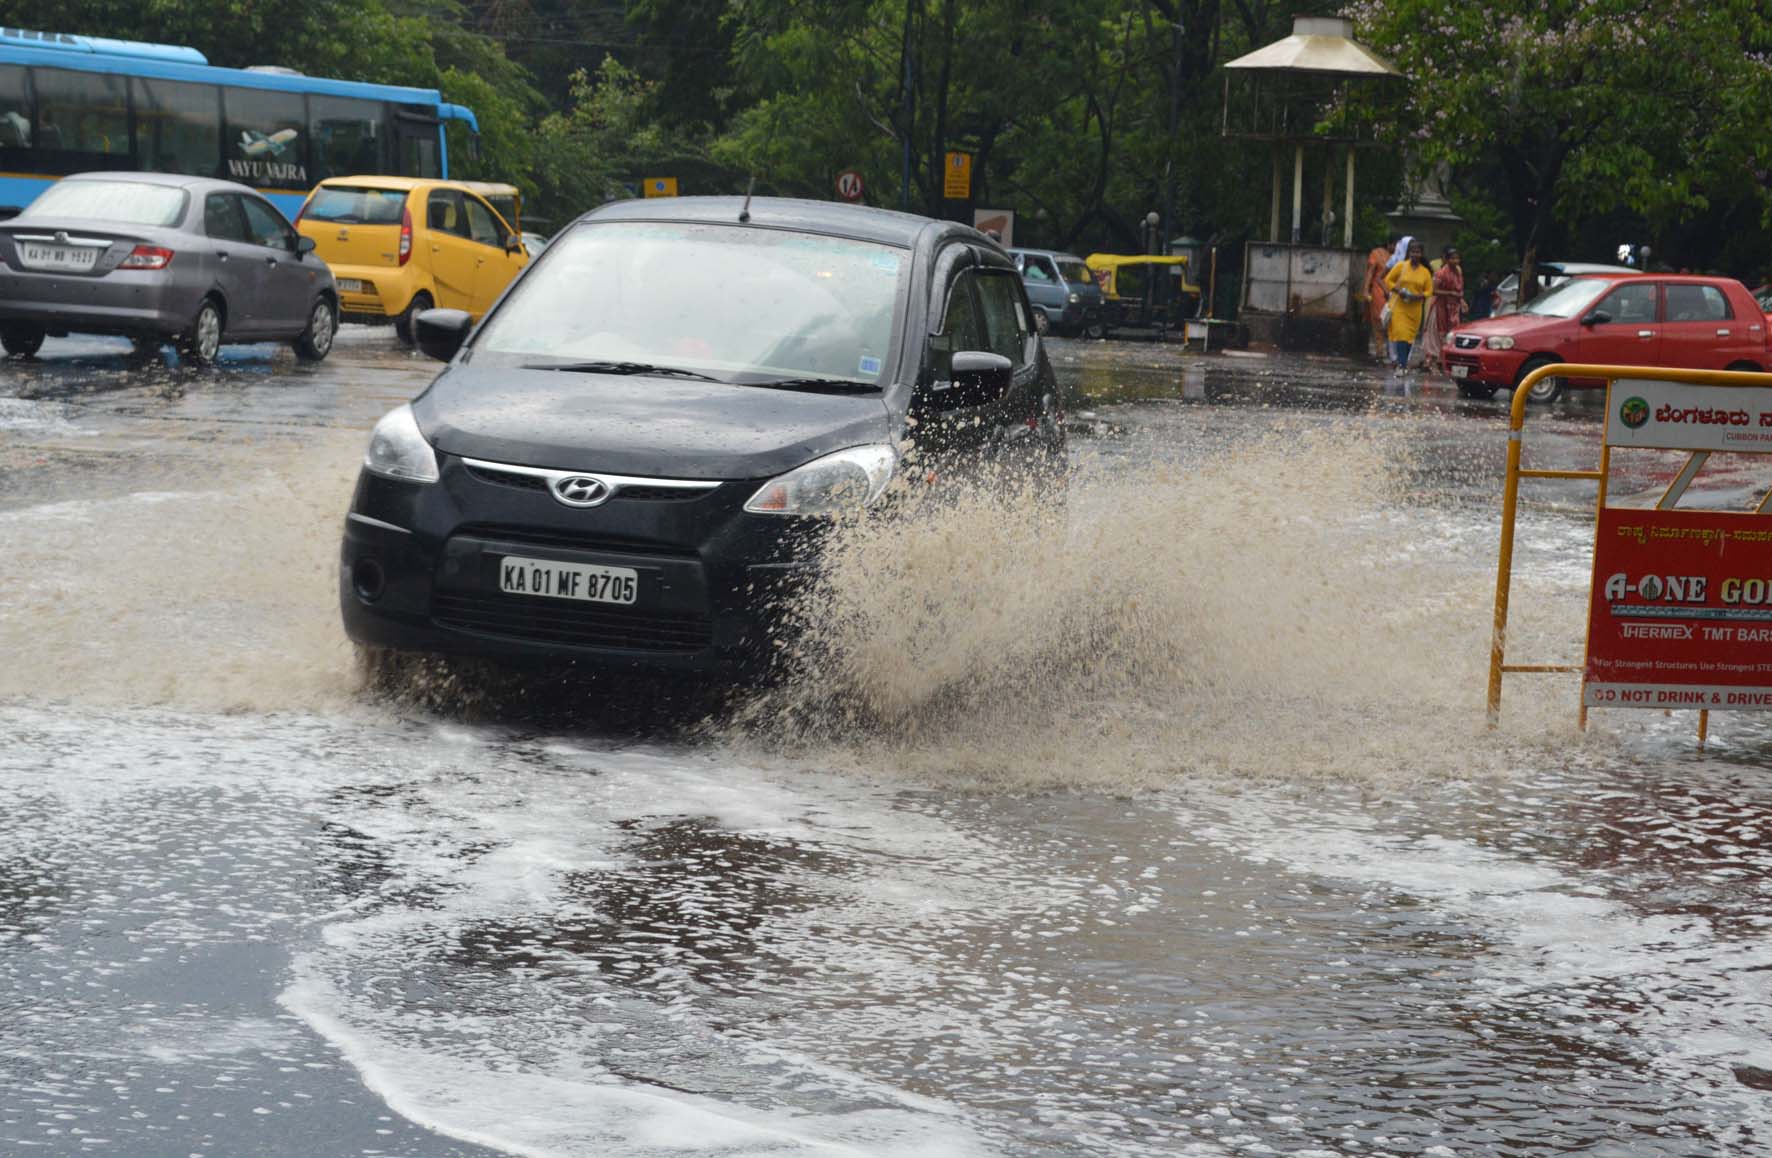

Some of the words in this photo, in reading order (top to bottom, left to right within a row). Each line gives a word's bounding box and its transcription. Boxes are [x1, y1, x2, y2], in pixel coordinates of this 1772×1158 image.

[228, 159, 262, 177] VAYU
[265, 161, 307, 181] VAJRA
[1655, 403, 1750, 426] ಬೆಂಗಳೂರು
[1726, 432, 1758, 441] CUBBON
[504, 565, 526, 591] KA
[532, 568, 550, 594] 01
[558, 571, 582, 597] MF
[588, 574, 635, 602] 8705
[1605, 573, 1708, 602] A-ONE
[1621, 622, 1693, 640] THERMEX
[1702, 627, 1735, 641] TMT
[1737, 628, 1772, 643] BAR
[1655, 661, 1697, 671] Structures
[1700, 662, 1715, 671] Use
[1716, 662, 1755, 673] Strongest
[1620, 690, 1653, 702] NOT
[1657, 691, 1705, 704] DRINK
[1711, 692, 1721, 704] &
[1727, 692, 1772, 705] DRIVE
